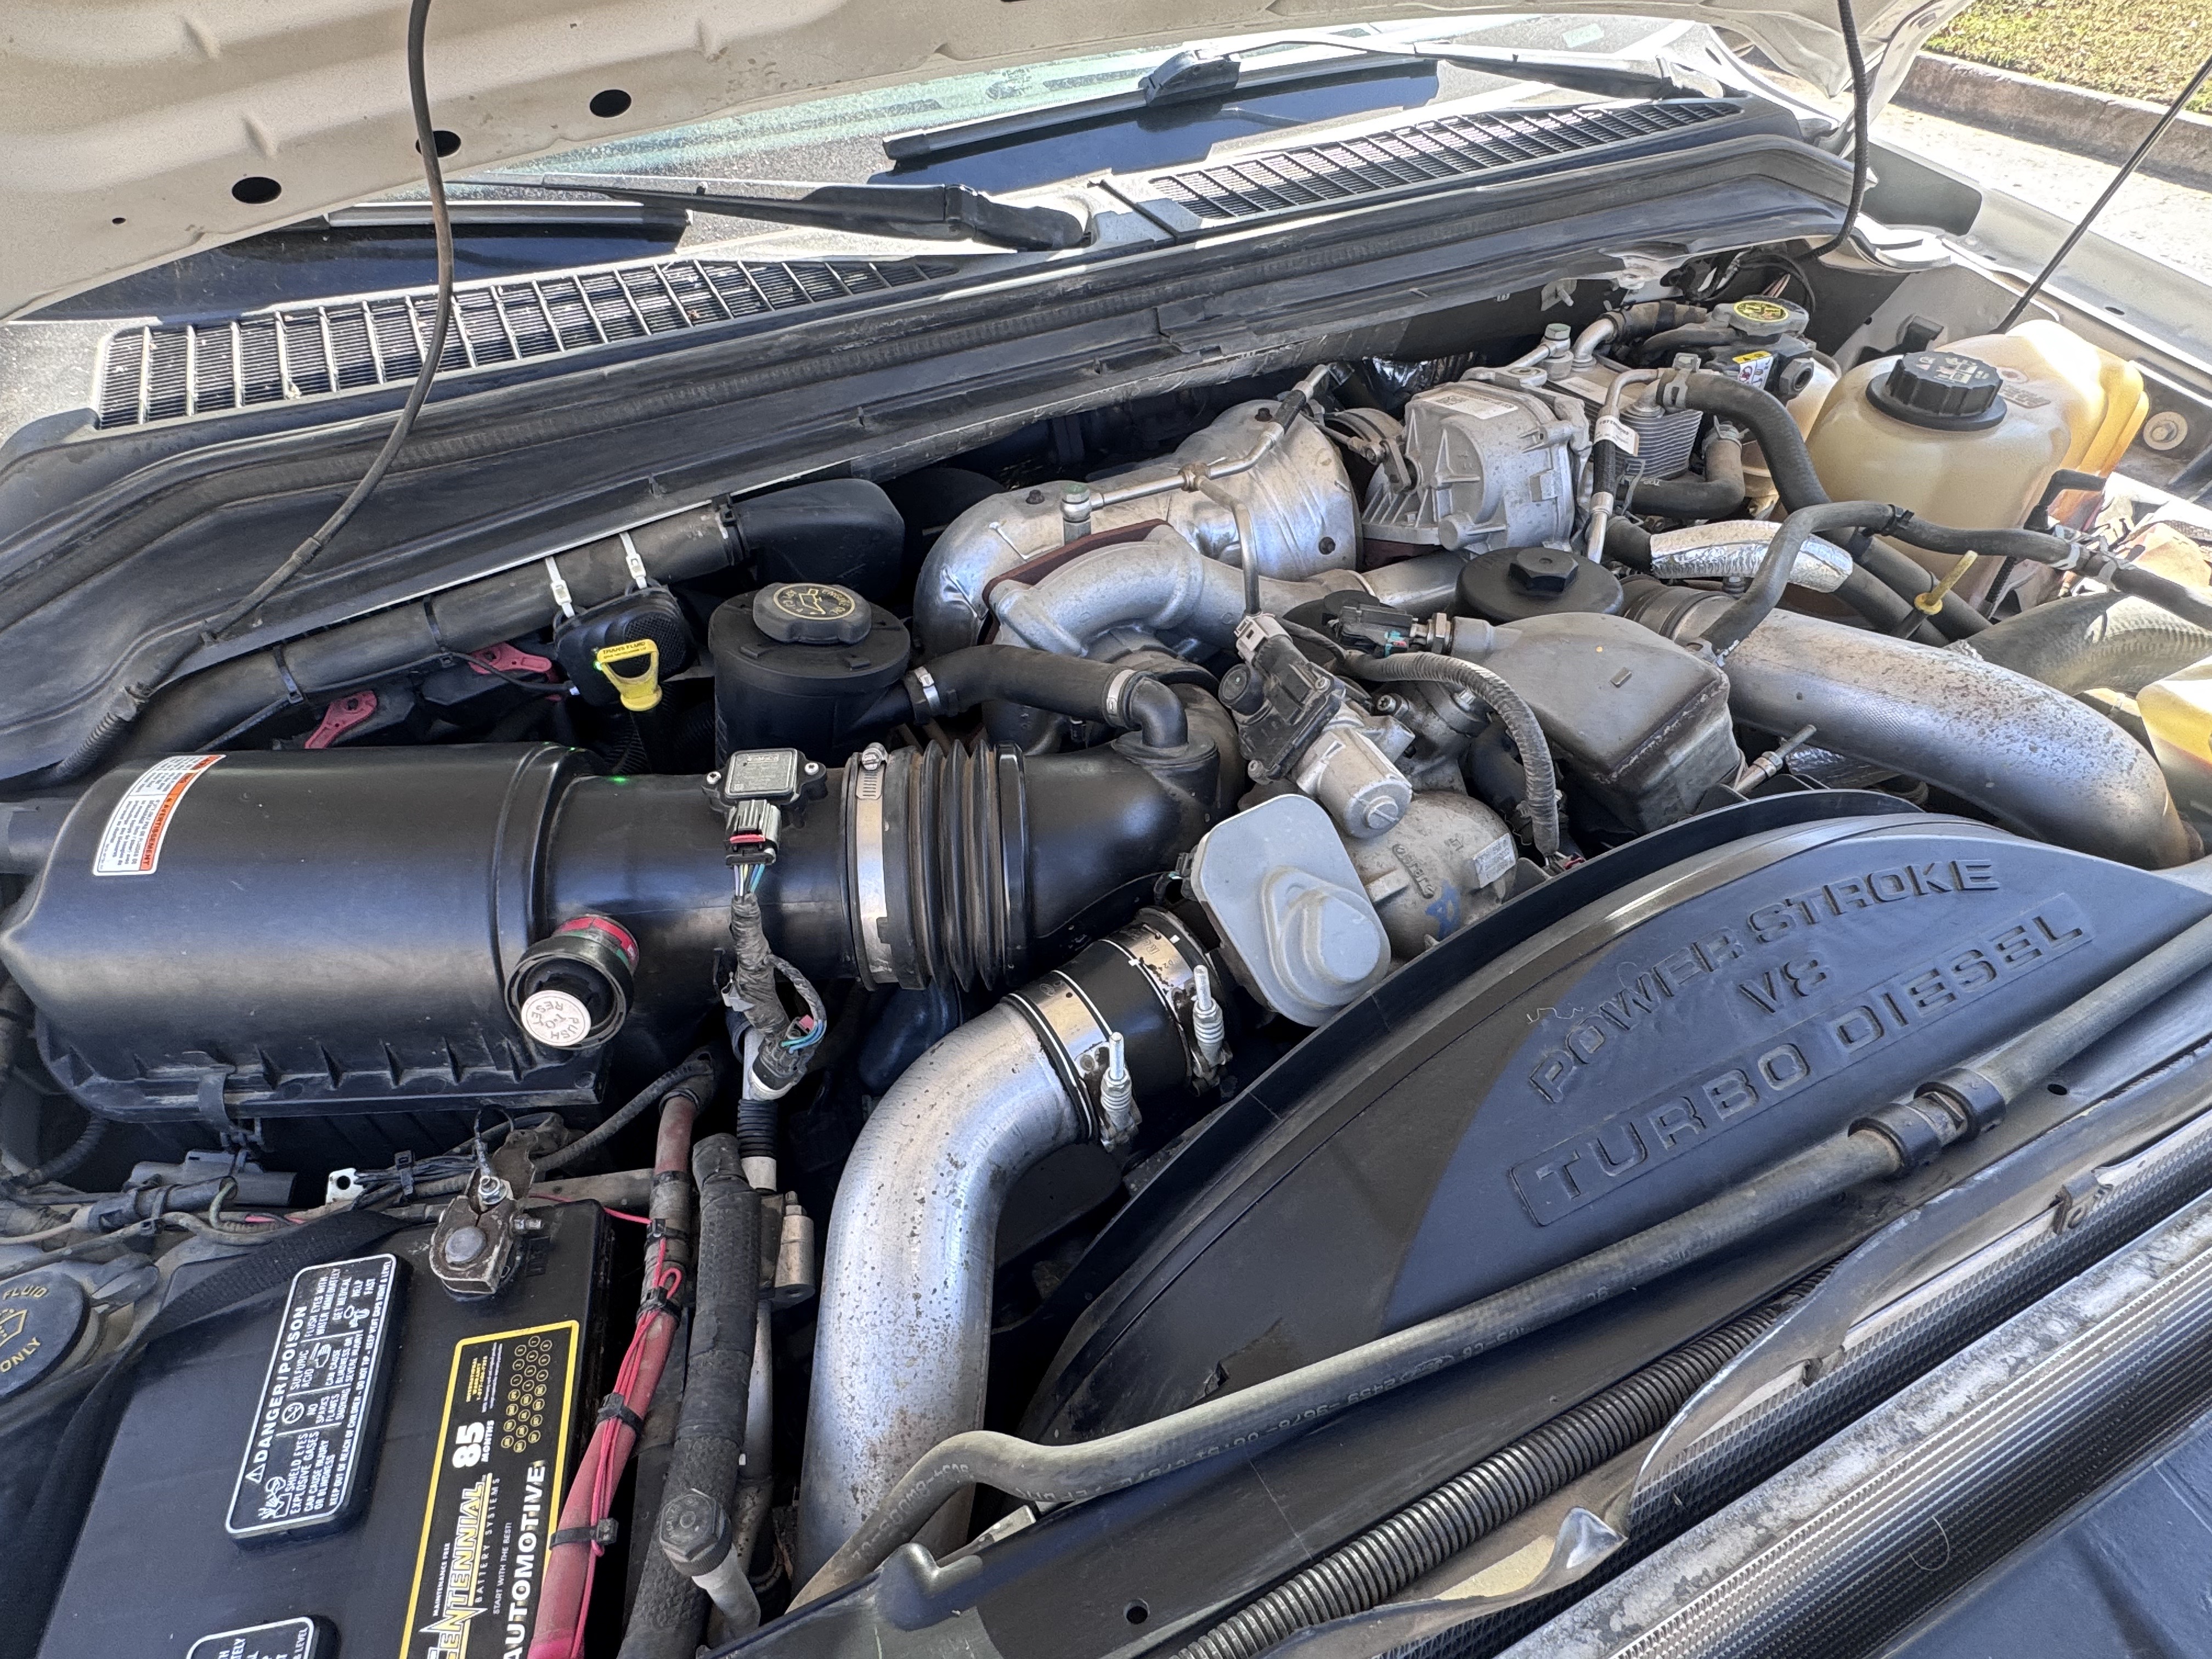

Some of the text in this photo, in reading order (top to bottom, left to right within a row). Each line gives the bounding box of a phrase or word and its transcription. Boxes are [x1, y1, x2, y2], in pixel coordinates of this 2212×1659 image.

[1739, 952, 1830, 1014] V8
[550, 1017, 579, 1040] PUSH
[1536, 915, 2085, 1203] TURBO DIESEL
[3, 1284, 48, 1300] FLUID
[351, 1279, 364, 1297] HELP
[363, 1278, 376, 1295] FAST
[304, 1314, 318, 1338] FLUSH
[311, 1295, 324, 1313] EYES
[316, 1312, 330, 1335] WATER
[332, 1307, 343, 1321] GET
[0, 1336, 41, 1372] ONLY
[253, 1306, 307, 1463] DANGER/POISON
[290, 1350, 309, 1390] SULFURIC
[301, 1368, 314, 1387] ACID
[307, 1403, 318, 1415] NO
[315, 1396, 330, 1424] SPARKS
[325, 1393, 340, 1422] FLAMES
[335, 1388, 351, 1420] SMOKING
[452, 1422, 484, 1468] 85
[481, 1420, 494, 1462] MONTHS
[285, 1433, 308, 1492] SHIELD EYES
[290, 1431, 320, 1514] EXPLOSIVE GASES
[309, 1469, 323, 1494] CAUSE
[314, 1454, 336, 1510] OR BLINDNESS
[304, 1496, 315, 1511] CAN
[475, 1478, 500, 1603] BATTERY SYSTEMS
[500, 1546, 509, 1562] THE
[497, 1565, 506, 1587] WITH
[503, 1465, 546, 1659] AUTOMOTIVE
[433, 1561, 449, 1617] MAINTENANCE
[493, 1588, 504, 1615] START
